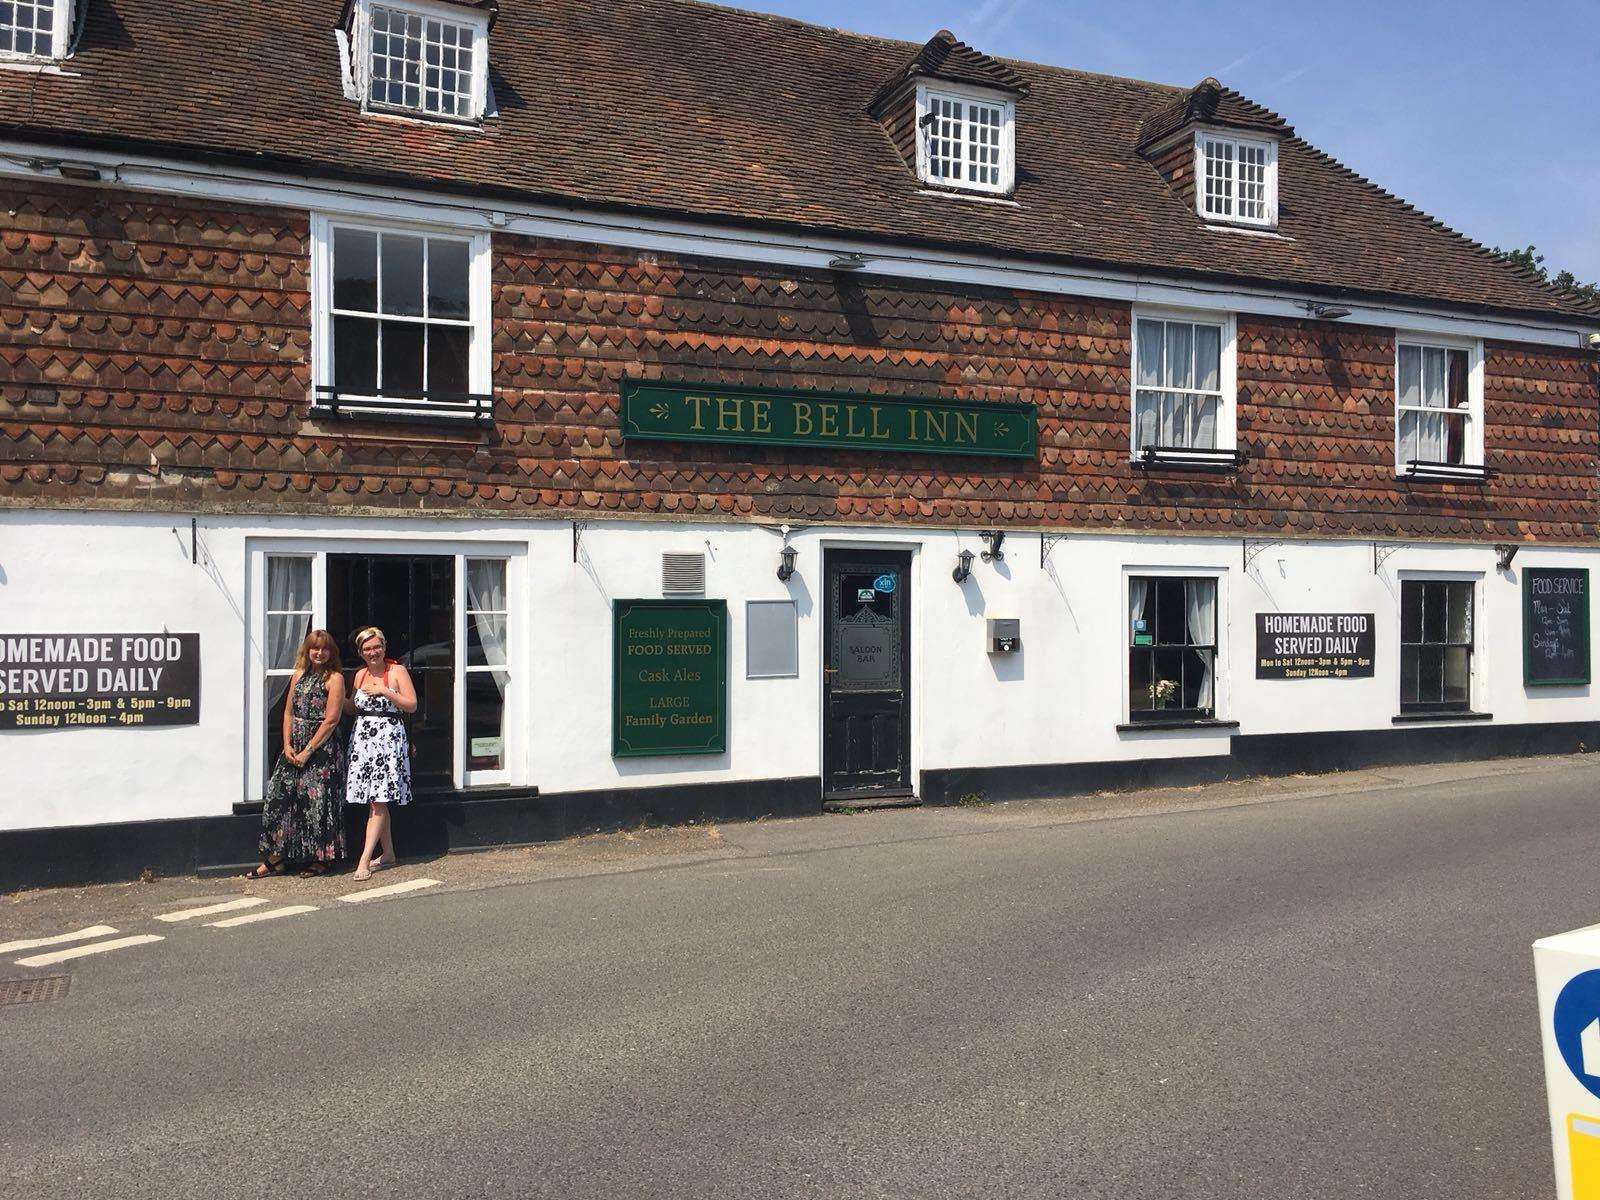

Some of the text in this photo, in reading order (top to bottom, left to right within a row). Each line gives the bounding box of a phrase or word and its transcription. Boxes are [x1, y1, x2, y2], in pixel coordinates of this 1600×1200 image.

[684, 396, 980, 443] THE BELL INN
[1533, 577, 1583, 594] FOOD SERVICE
[1265, 616, 1367, 633] HOMEMADE FOOD
[628, 627, 711, 640] Freshly Prepared
[121, 637, 182, 662] FOOD
[628, 644, 712, 656] FOOD SERVED
[849, 645, 882, 655] SALOON
[1275, 637, 1359, 655] SERVED DAILY
[857, 655, 876, 663] BAR
[1260, 658, 1274, 667] Mon
[1275, 658, 1282, 667] to
[1282, 658, 1293, 667] Sat
[1333, 657, 1338, 666] &
[97, 667, 163, 692] DAILY
[638, 668, 701, 682] Cask Ales
[1285, 668, 1306, 678] Sunday
[8, 699, 29, 711] Sat
[116, 697, 126, 709] &
[130, 697, 155, 710] 5pm
[166, 696, 191, 710] 9pm
[650, 697, 690, 708] LARGE
[16, 714, 60, 726] Sunday
[64, 712, 107, 724] 12Noon
[119, 711, 144, 725] 4pm
[625, 713, 713, 728] Family Garden
